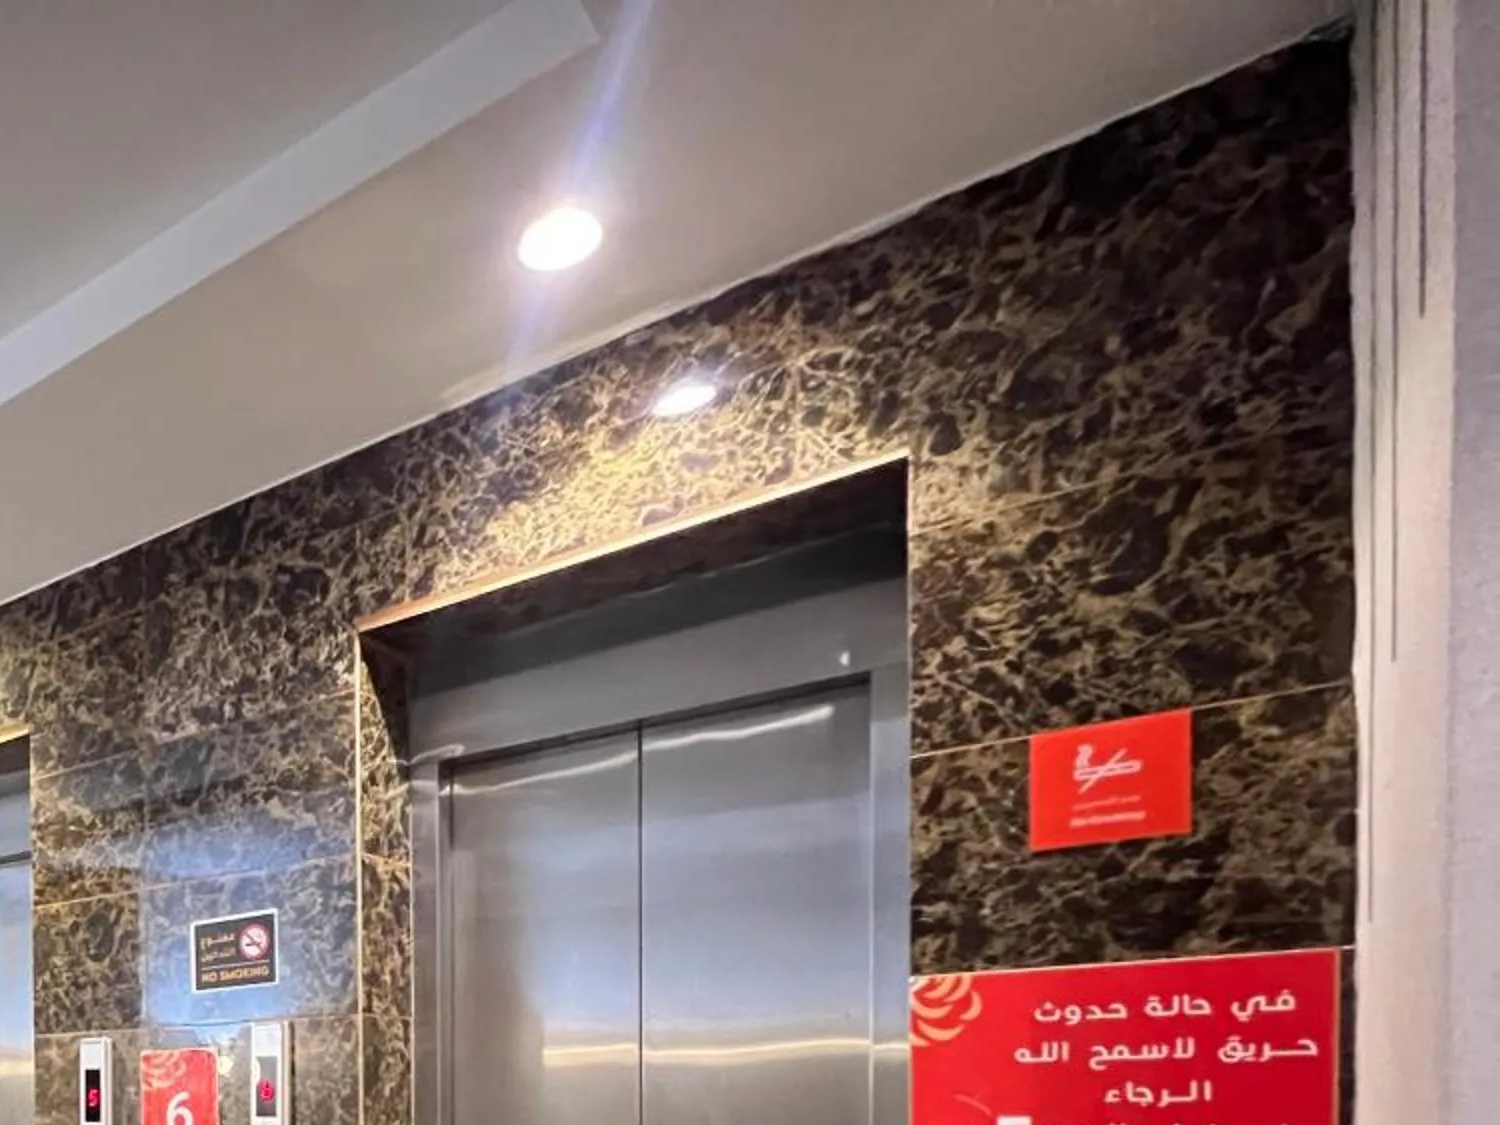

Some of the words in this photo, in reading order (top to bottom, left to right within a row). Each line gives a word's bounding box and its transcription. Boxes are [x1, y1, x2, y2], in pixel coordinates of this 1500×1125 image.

[202, 971, 219, 983] NO
[220, 965, 269, 982] SMOKING
[1034, 1000, 1129, 1026] حدوث
[1143, 993, 1211, 1018] حالة
[1230, 989, 1297, 1021] في
[1014, 1042, 1069, 1063] الله
[1088, 1037, 1196, 1070] لاسمح
[1217, 1035, 1318, 1064] حريق
[1104, 1080, 1212, 1108] الرجاء
